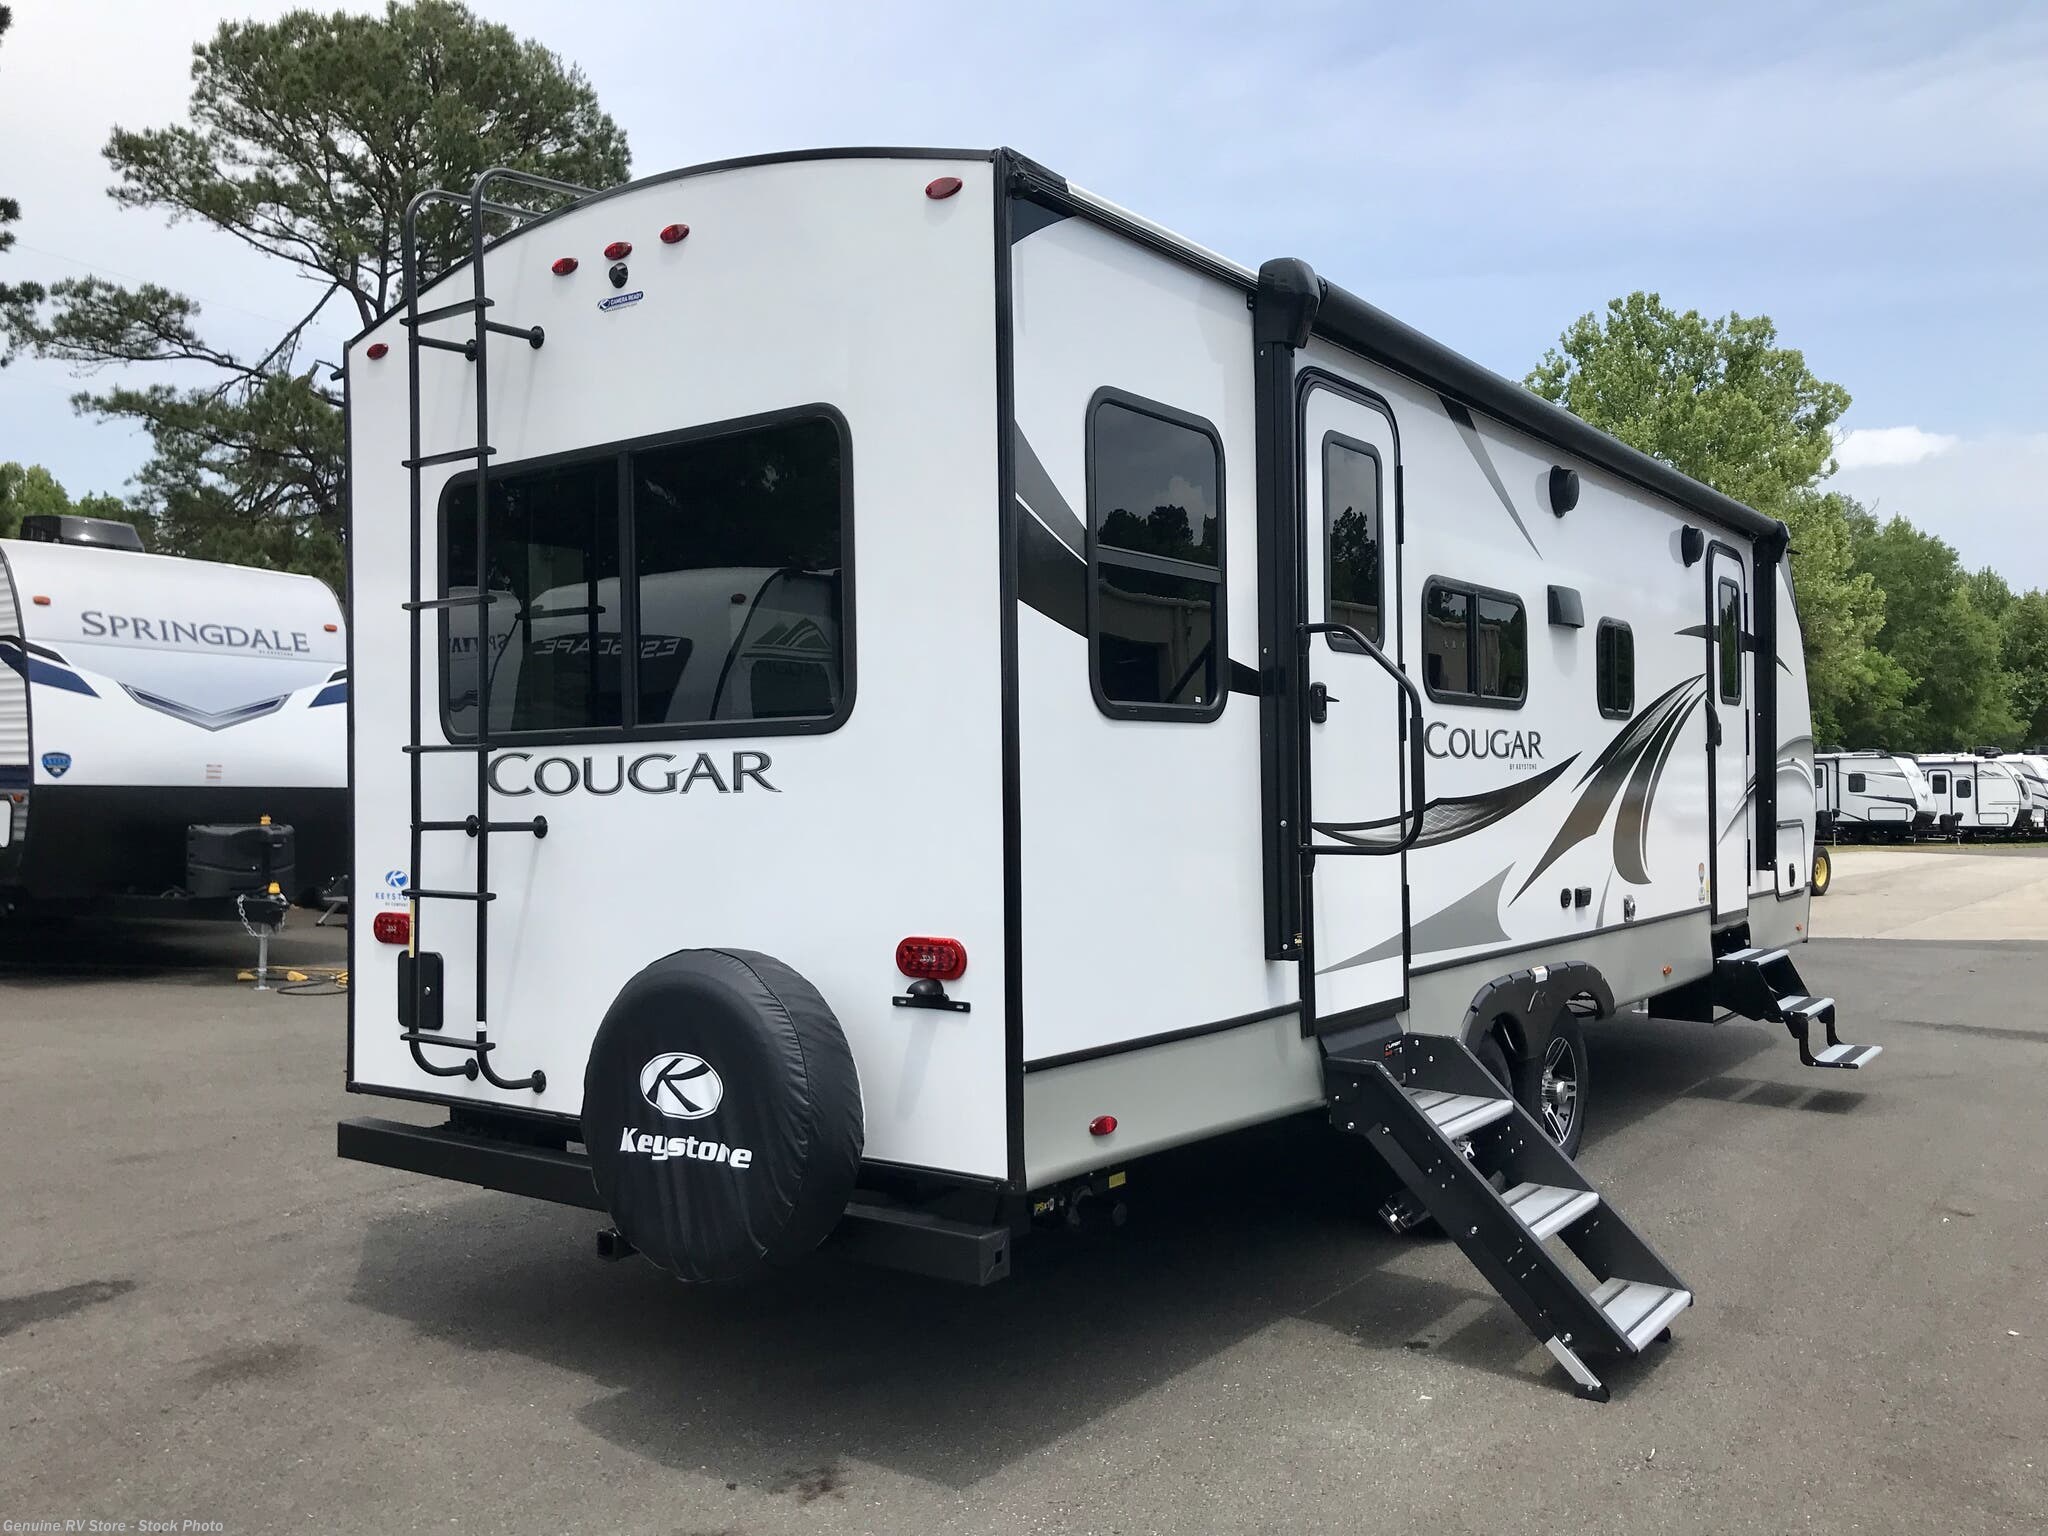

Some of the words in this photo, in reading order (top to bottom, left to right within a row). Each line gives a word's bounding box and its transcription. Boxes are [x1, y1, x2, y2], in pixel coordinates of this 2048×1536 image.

[81, 611, 310, 653] SPRINGDALE
[1424, 721, 1544, 759] COUGAR
[488, 751, 783, 796] COUGAR
[620, 1127, 753, 1169] Keystone
